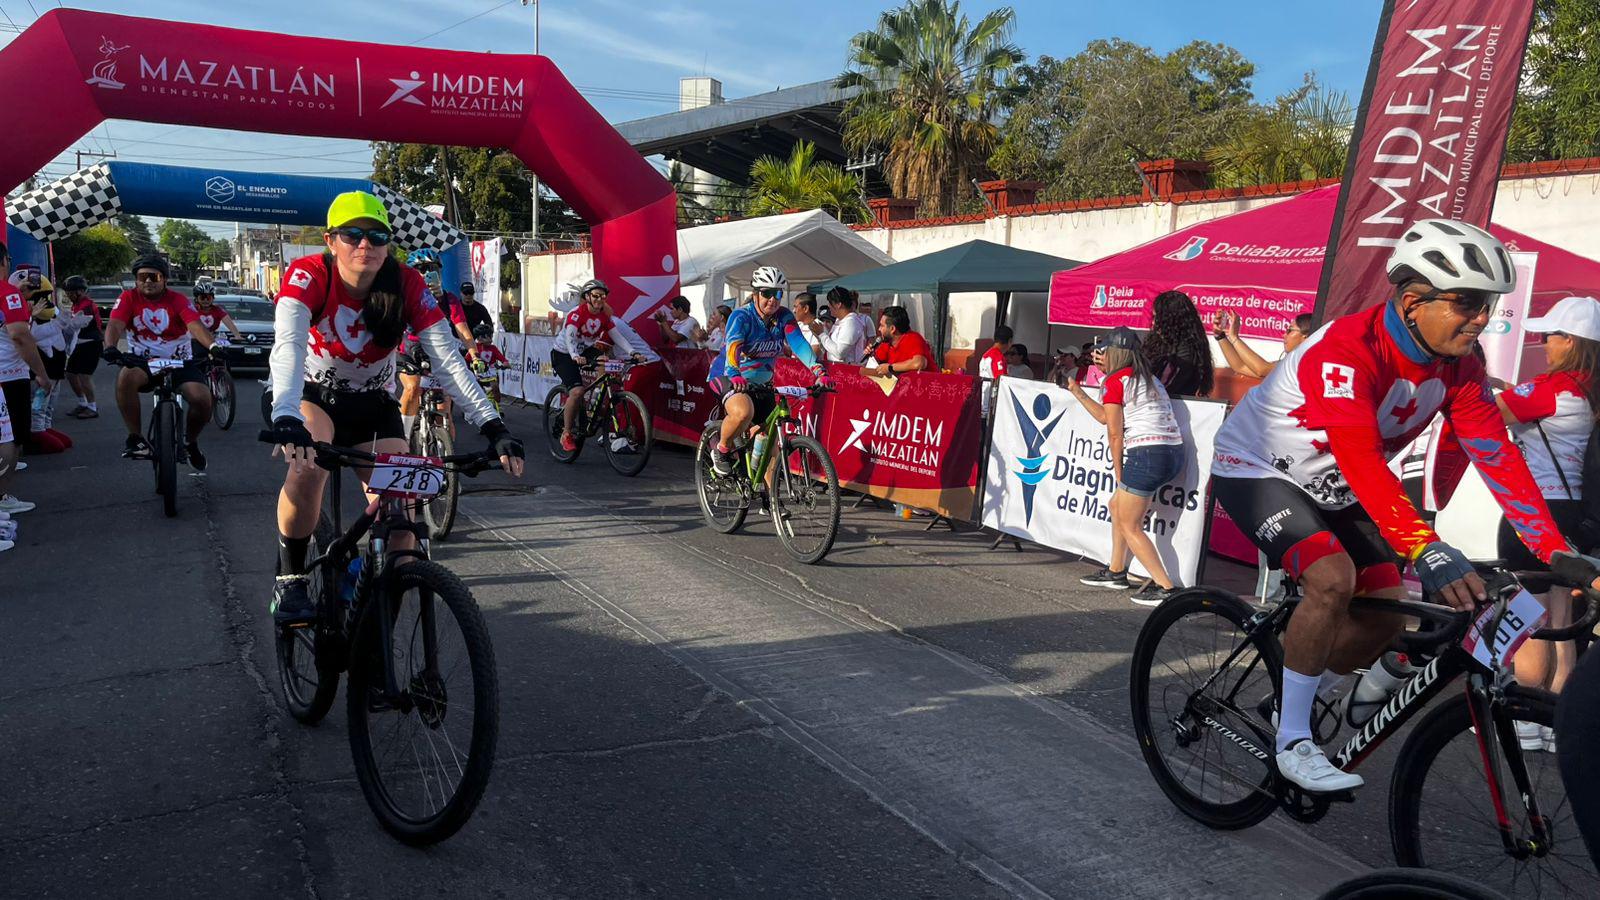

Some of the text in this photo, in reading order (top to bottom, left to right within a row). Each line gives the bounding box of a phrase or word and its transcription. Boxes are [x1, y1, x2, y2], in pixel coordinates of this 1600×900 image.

[1479, 23, 1502, 81] DEPORTE
[139, 53, 336, 98] MAZATLÁN
[432, 72, 525, 97] IMDEM
[140, 84, 336, 111] BIENESTAR PARA TODOS
[431, 95, 523, 112] MAZATLÁN
[1474, 85, 1490, 109] DEL
[1357, 24, 1448, 248] IMDEM
[1413, 23, 1487, 223] AZATLÁN
[1458, 111, 1482, 185] MUNICIPAL
[249, 185, 288, 194] ENCANTO
[1208, 242, 1327, 258] DeliaBarraz
[1108, 286, 1134, 297] Delia
[1199, 294, 1244, 307] certeza
[1245, 294, 1262, 308] de
[1262, 299, 1305, 313] recibir
[872, 410, 944, 447] IMDEM
[870, 438, 940, 468] MAZATLÁN
[388, 469, 431, 491] 238
[1056, 489, 1078, 514] de
[1335, 659, 1439, 770] SPECIALIZED
[1203, 716, 1269, 761] SPECIALIZED
